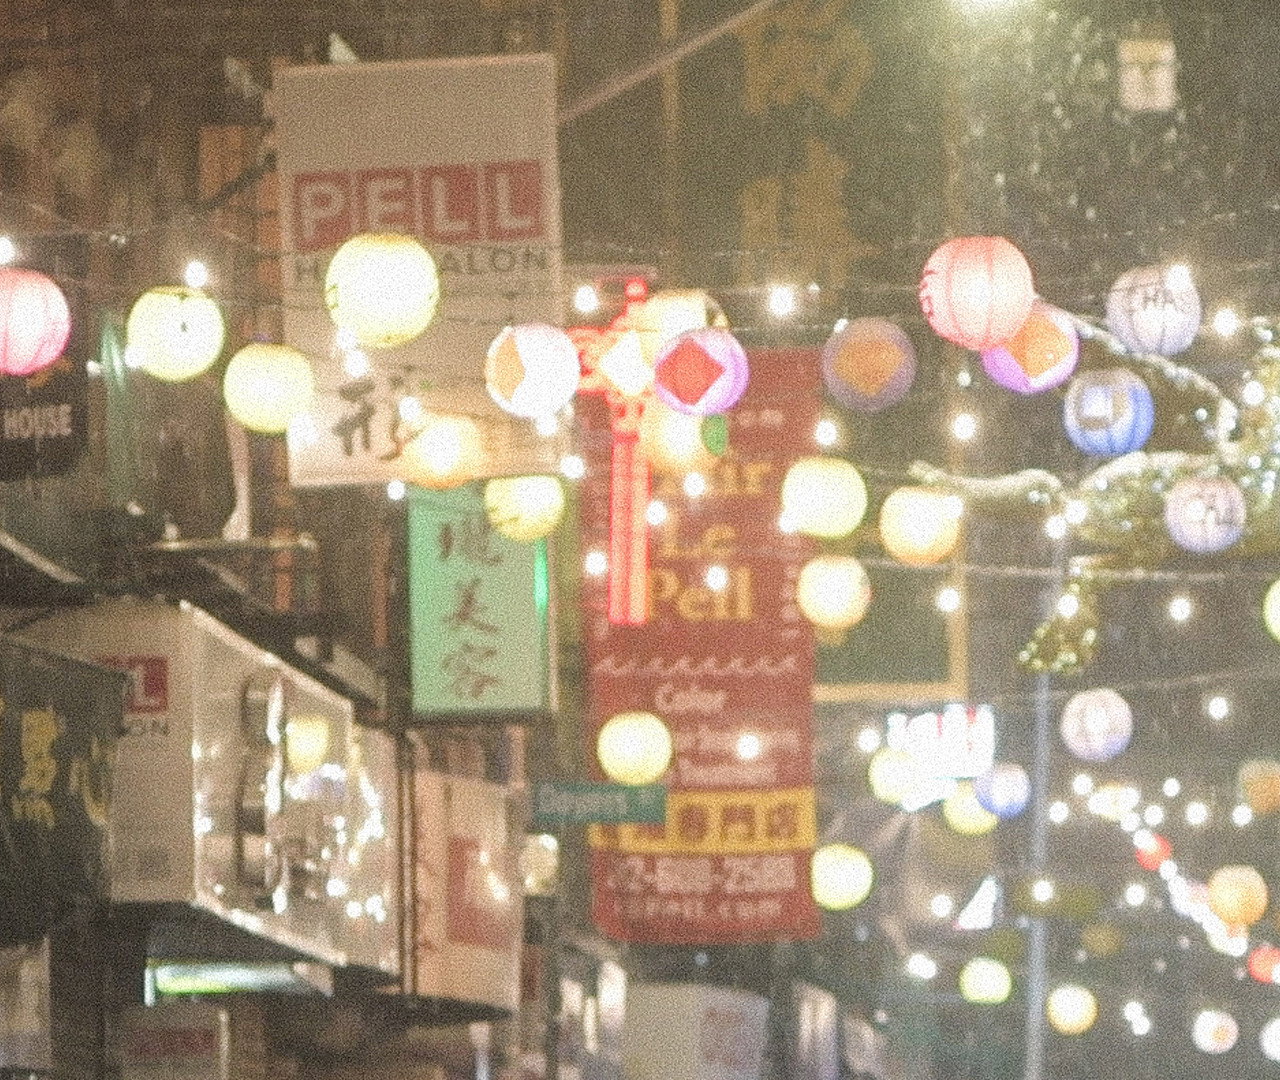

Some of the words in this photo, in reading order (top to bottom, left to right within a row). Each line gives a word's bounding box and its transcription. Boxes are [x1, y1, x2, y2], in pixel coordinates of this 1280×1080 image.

[299, 172, 535, 245] PELL
[439, 247, 548, 275] ALON
[3, 404, 72, 438] HOUSE
